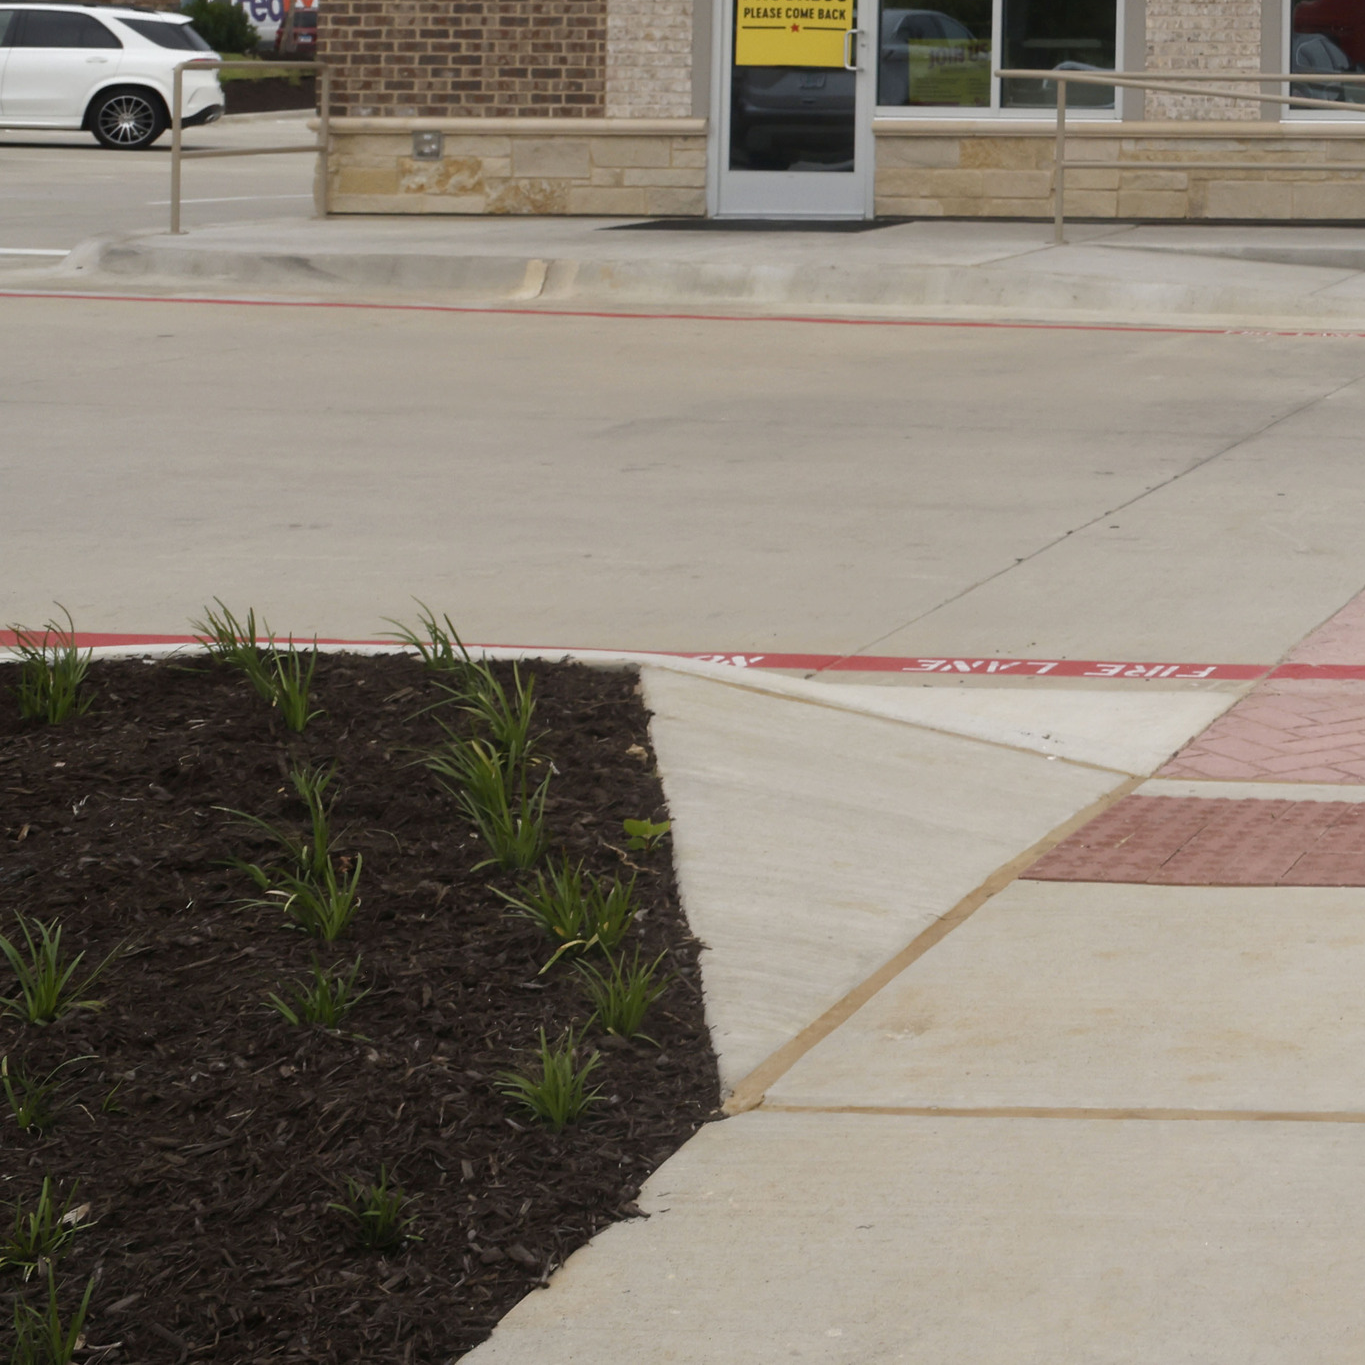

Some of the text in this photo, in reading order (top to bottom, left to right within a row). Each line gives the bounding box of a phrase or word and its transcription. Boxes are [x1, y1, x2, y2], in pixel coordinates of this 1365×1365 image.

[744, 7, 846, 20] PLEASE COME BACK
[901, 659, 1059, 674] LANE
[1083, 663, 1217, 679] FIRE
